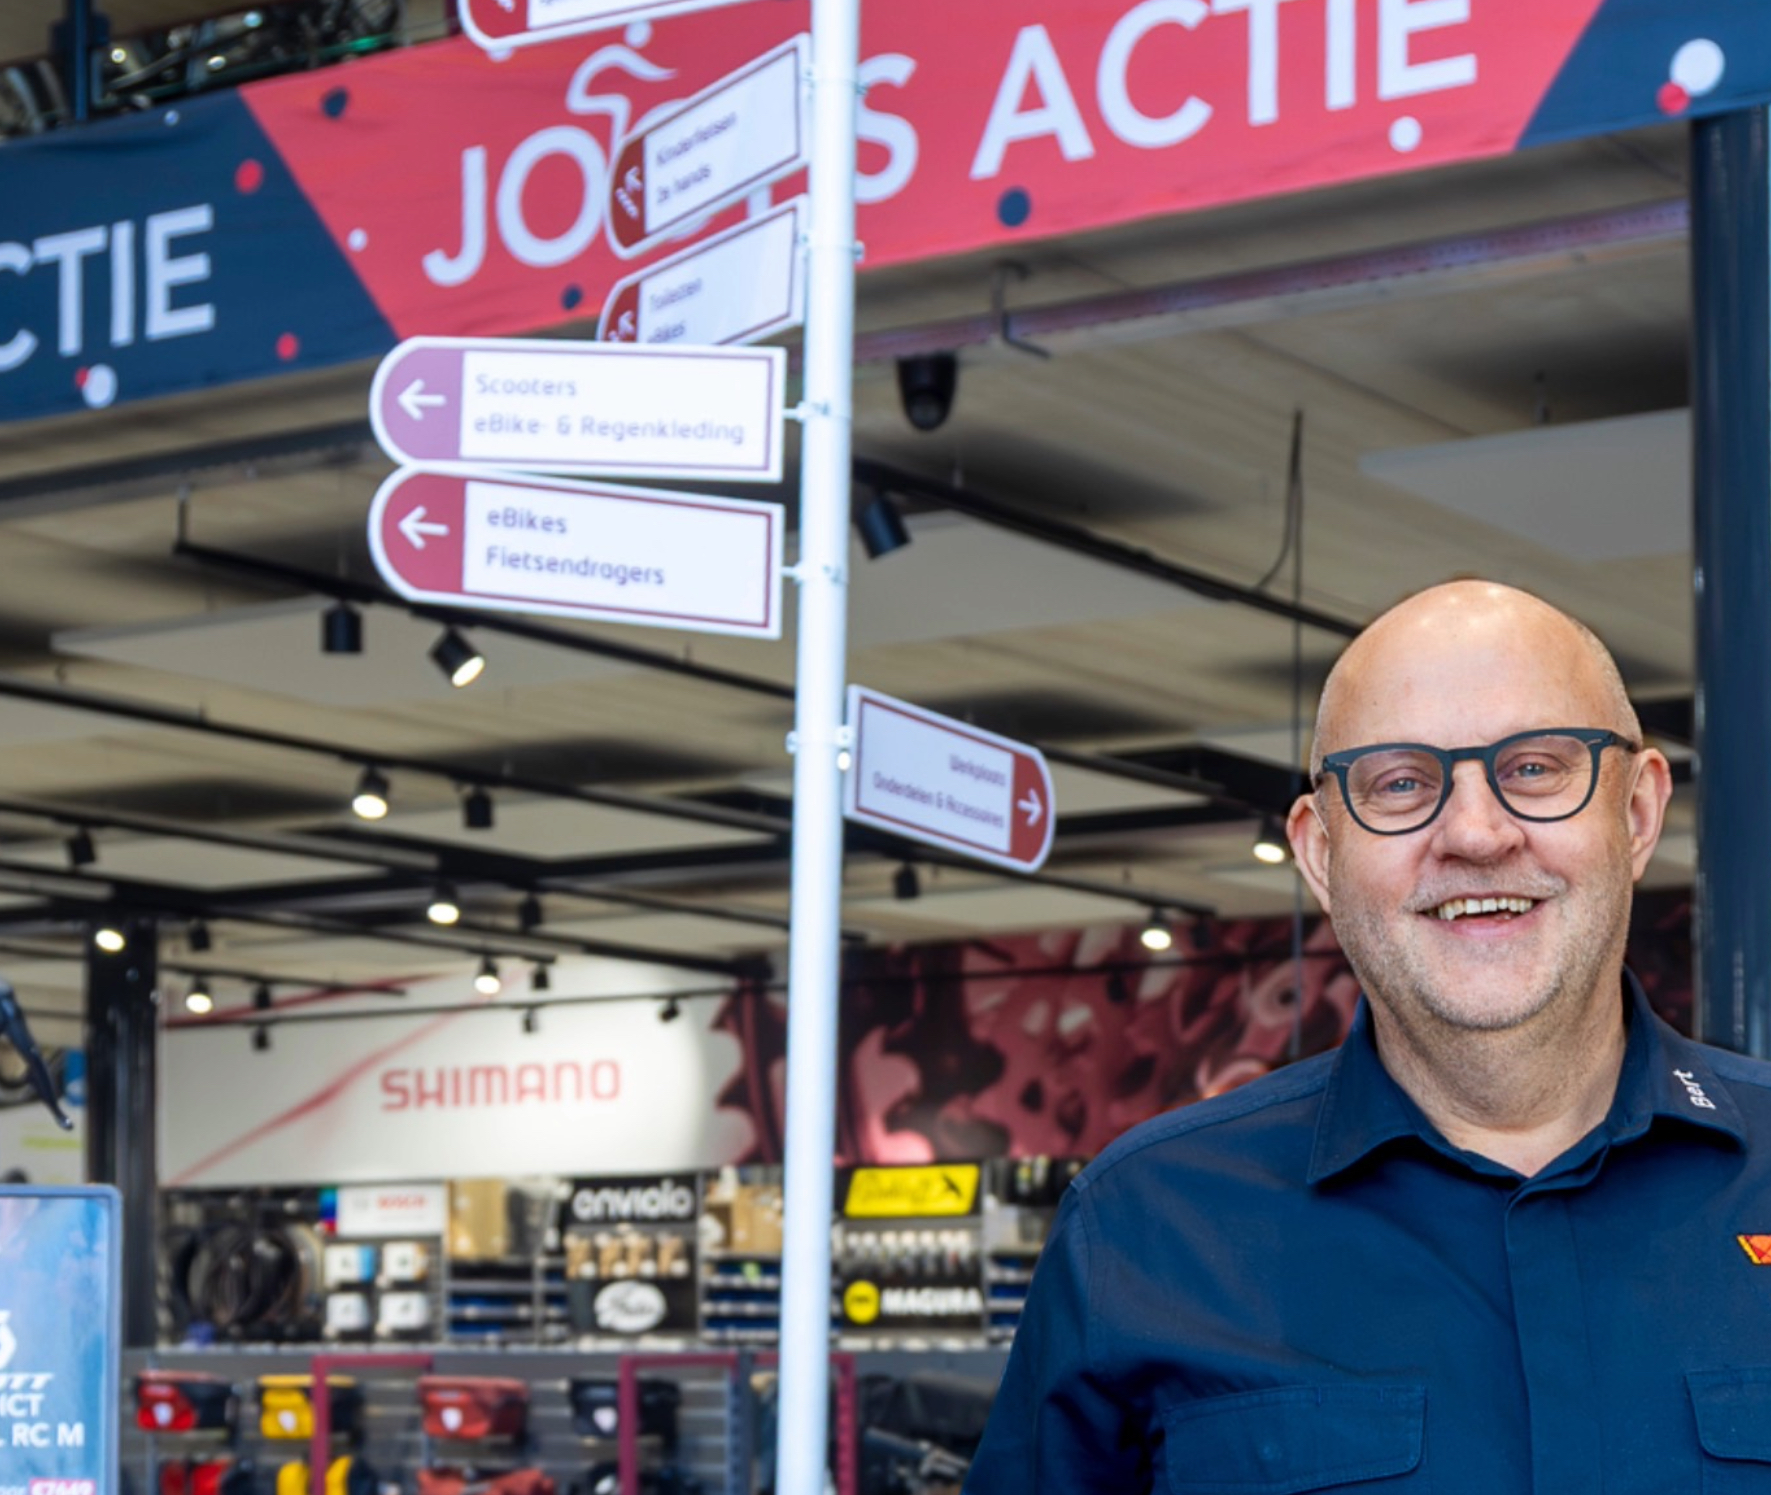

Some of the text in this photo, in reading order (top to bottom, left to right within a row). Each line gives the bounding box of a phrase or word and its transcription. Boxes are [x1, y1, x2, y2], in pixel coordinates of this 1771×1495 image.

[423, 0, 1477, 287] JOS ACTIE
[475, 373, 578, 397] Scooters
[556, 415, 572, 436] &
[581, 415, 746, 446] Regenkleding
[486, 507, 568, 534] eBikes
[486, 545, 666, 586] Fietsendragers
[380, 1059, 623, 1112] SHIMANO
[12, 1423, 50, 1447] RC
[57, 1423, 84, 1447] M
